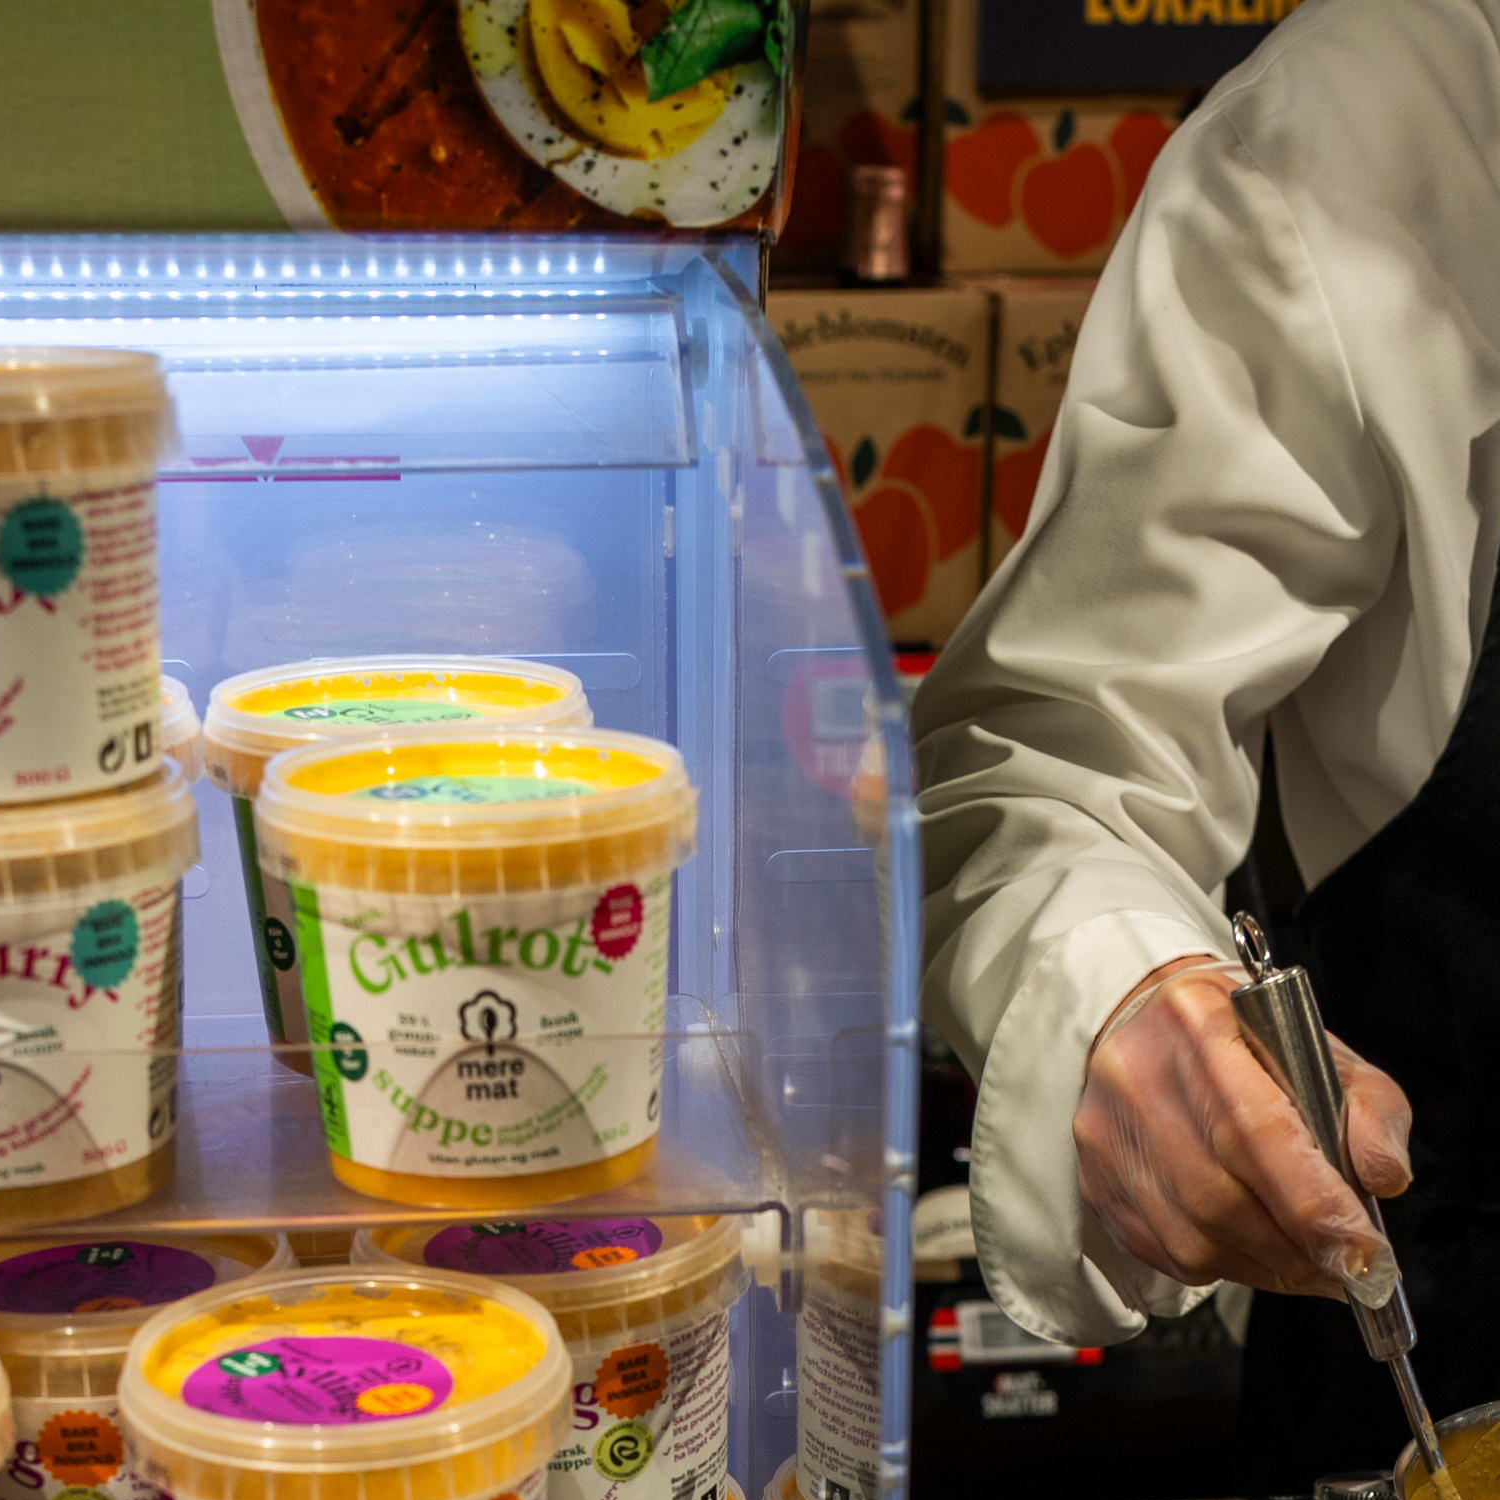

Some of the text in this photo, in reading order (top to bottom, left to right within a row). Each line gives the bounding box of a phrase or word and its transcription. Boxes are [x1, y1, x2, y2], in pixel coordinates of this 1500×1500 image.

[456, 1056, 526, 1080] mere
[465, 1079, 520, 1101] mat
[371, 1068, 496, 1149] suppe
[616, 1354, 650, 1373] BARE
[621, 1369, 648, 1386] BRA
[606, 1378, 662, 1402] INNHOLD
